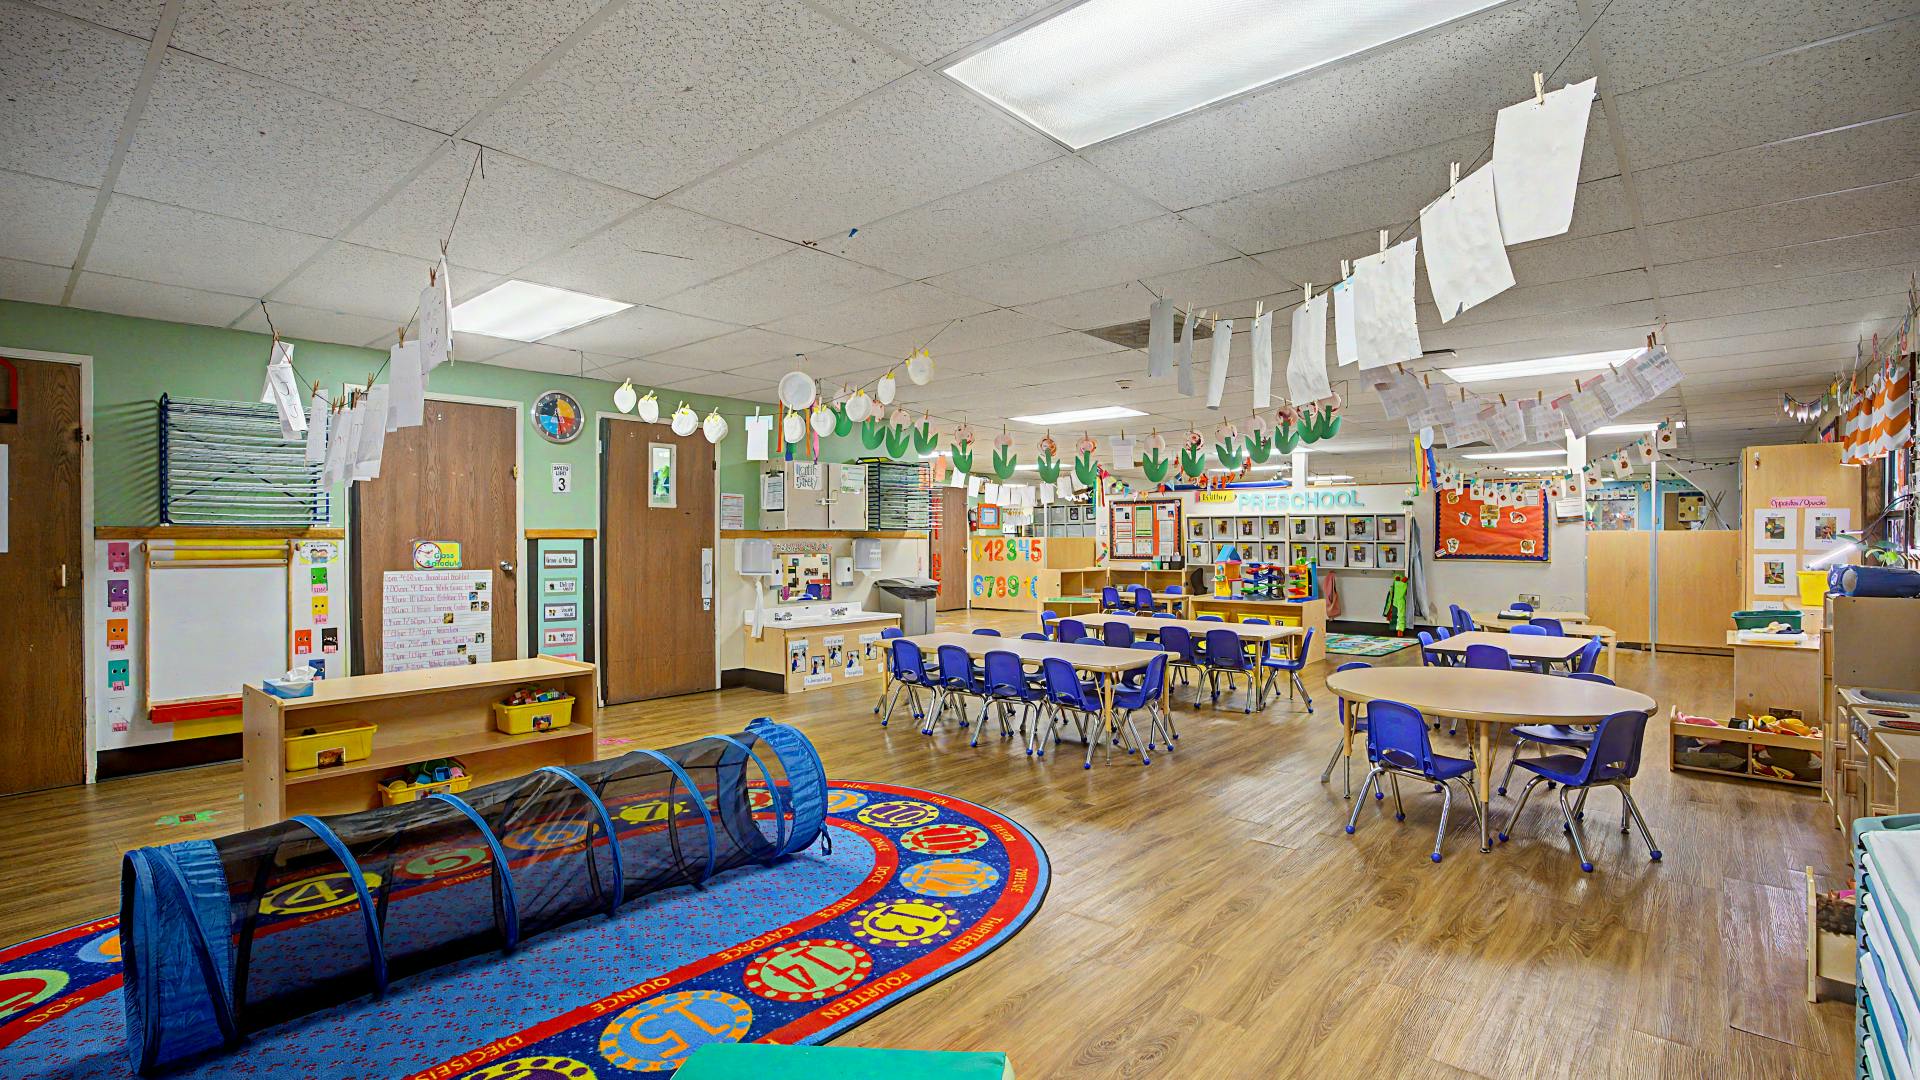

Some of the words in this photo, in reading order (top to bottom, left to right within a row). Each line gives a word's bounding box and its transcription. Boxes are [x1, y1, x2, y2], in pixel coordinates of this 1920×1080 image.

[558, 477, 566, 491] 3
[1238, 489, 1365, 512] PRESCHOOL
[631, 803, 663, 820] 7
[871, 804, 928, 824] 10
[870, 837, 890, 852] ONCE
[918, 830, 972, 848] 11
[867, 865, 891, 884] DOCE
[917, 868, 981, 886] 12
[1011, 868, 1028, 893] TWELVE
[283, 880, 345, 905] 4
[815, 897, 859, 919] TRECE
[868, 905, 942, 937] 13
[719, 926, 795, 961] CATORCE
[950, 916, 1004, 954] THIRTEEN
[764, 946, 852, 991] 14
[592, 977, 671, 1014] QUINCE
[820, 972, 913, 1019] FOURTEEN
[24, 996, 85, 1023] DOS
[629, 1000, 730, 1059] 15
